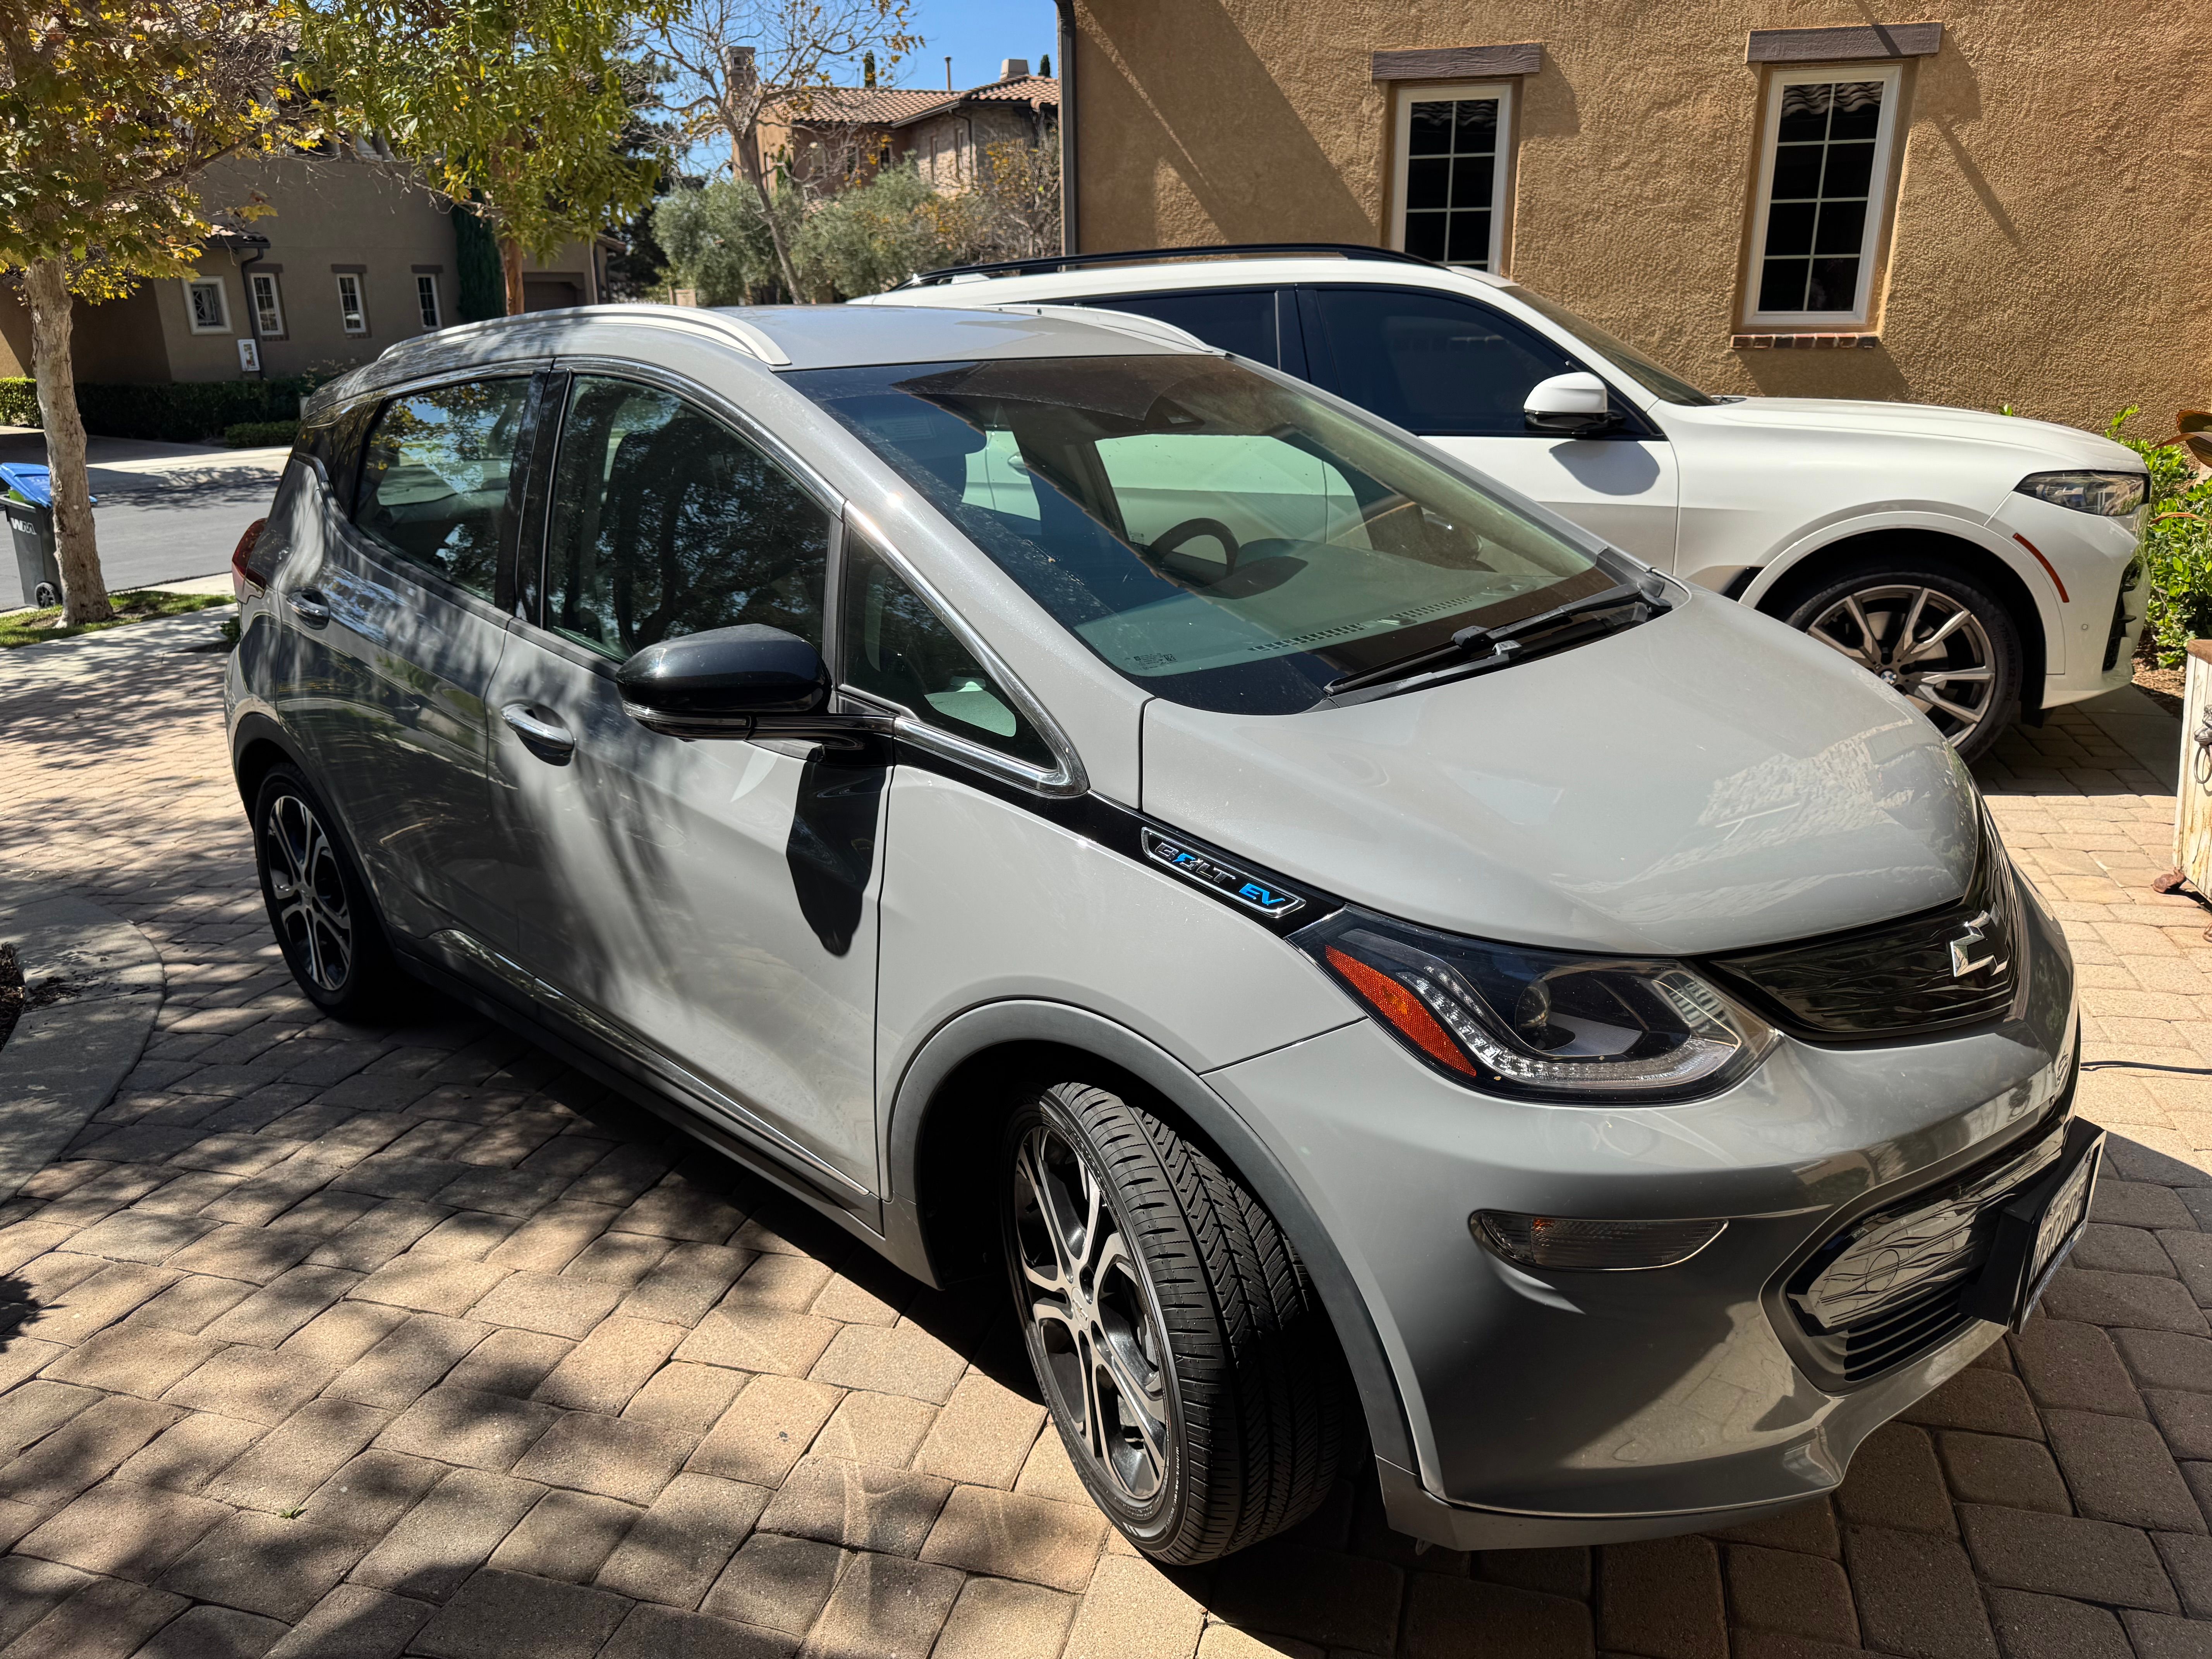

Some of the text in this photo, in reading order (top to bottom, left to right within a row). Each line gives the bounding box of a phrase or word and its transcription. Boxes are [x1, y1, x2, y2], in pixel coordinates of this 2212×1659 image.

[10, 517, 37, 535] WM
[1154, 842, 1286, 906] BOLT EV
